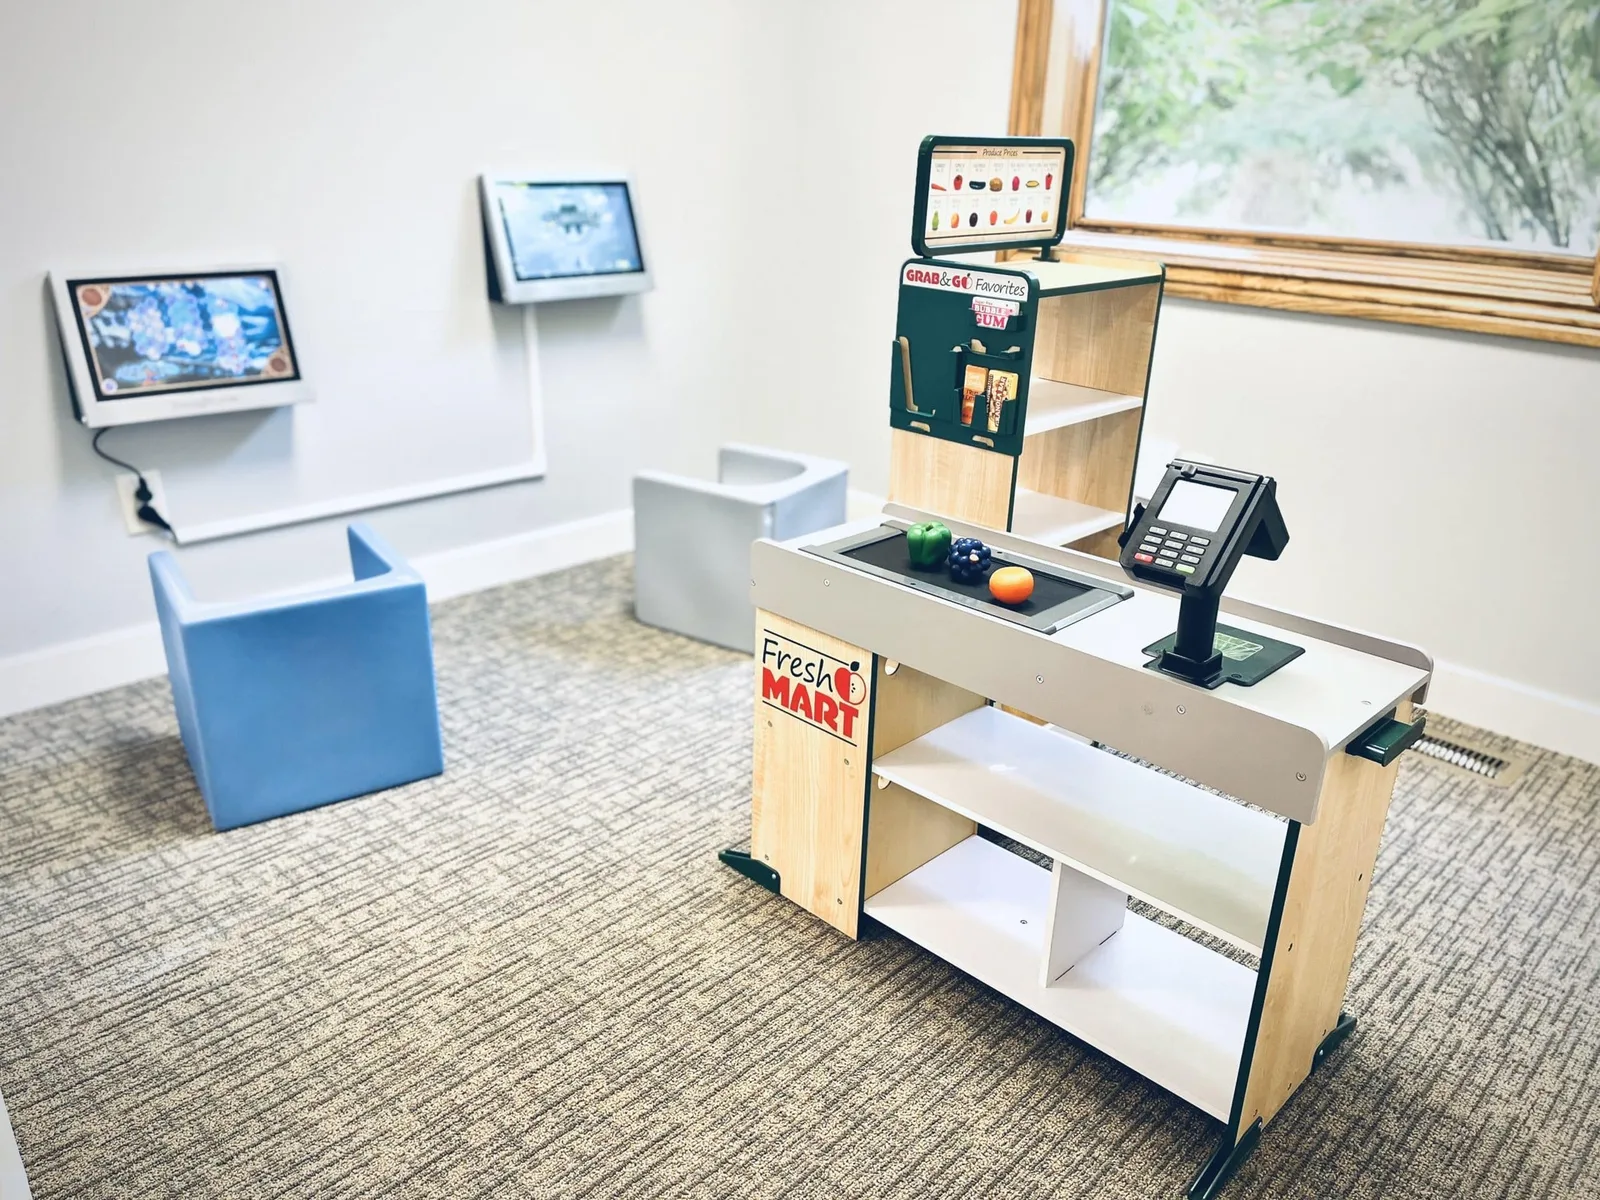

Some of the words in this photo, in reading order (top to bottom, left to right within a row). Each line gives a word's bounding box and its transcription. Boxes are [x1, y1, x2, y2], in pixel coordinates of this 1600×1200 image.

[982, 148, 1002, 157] Produce
[1003, 148, 1018, 157] Prices
[975, 278, 1026, 297] Favorites
[974, 304, 1007, 316] BUBBLE
[975, 312, 1006, 329] GUM
[762, 637, 834, 693] Fresh
[761, 666, 860, 739] MART
